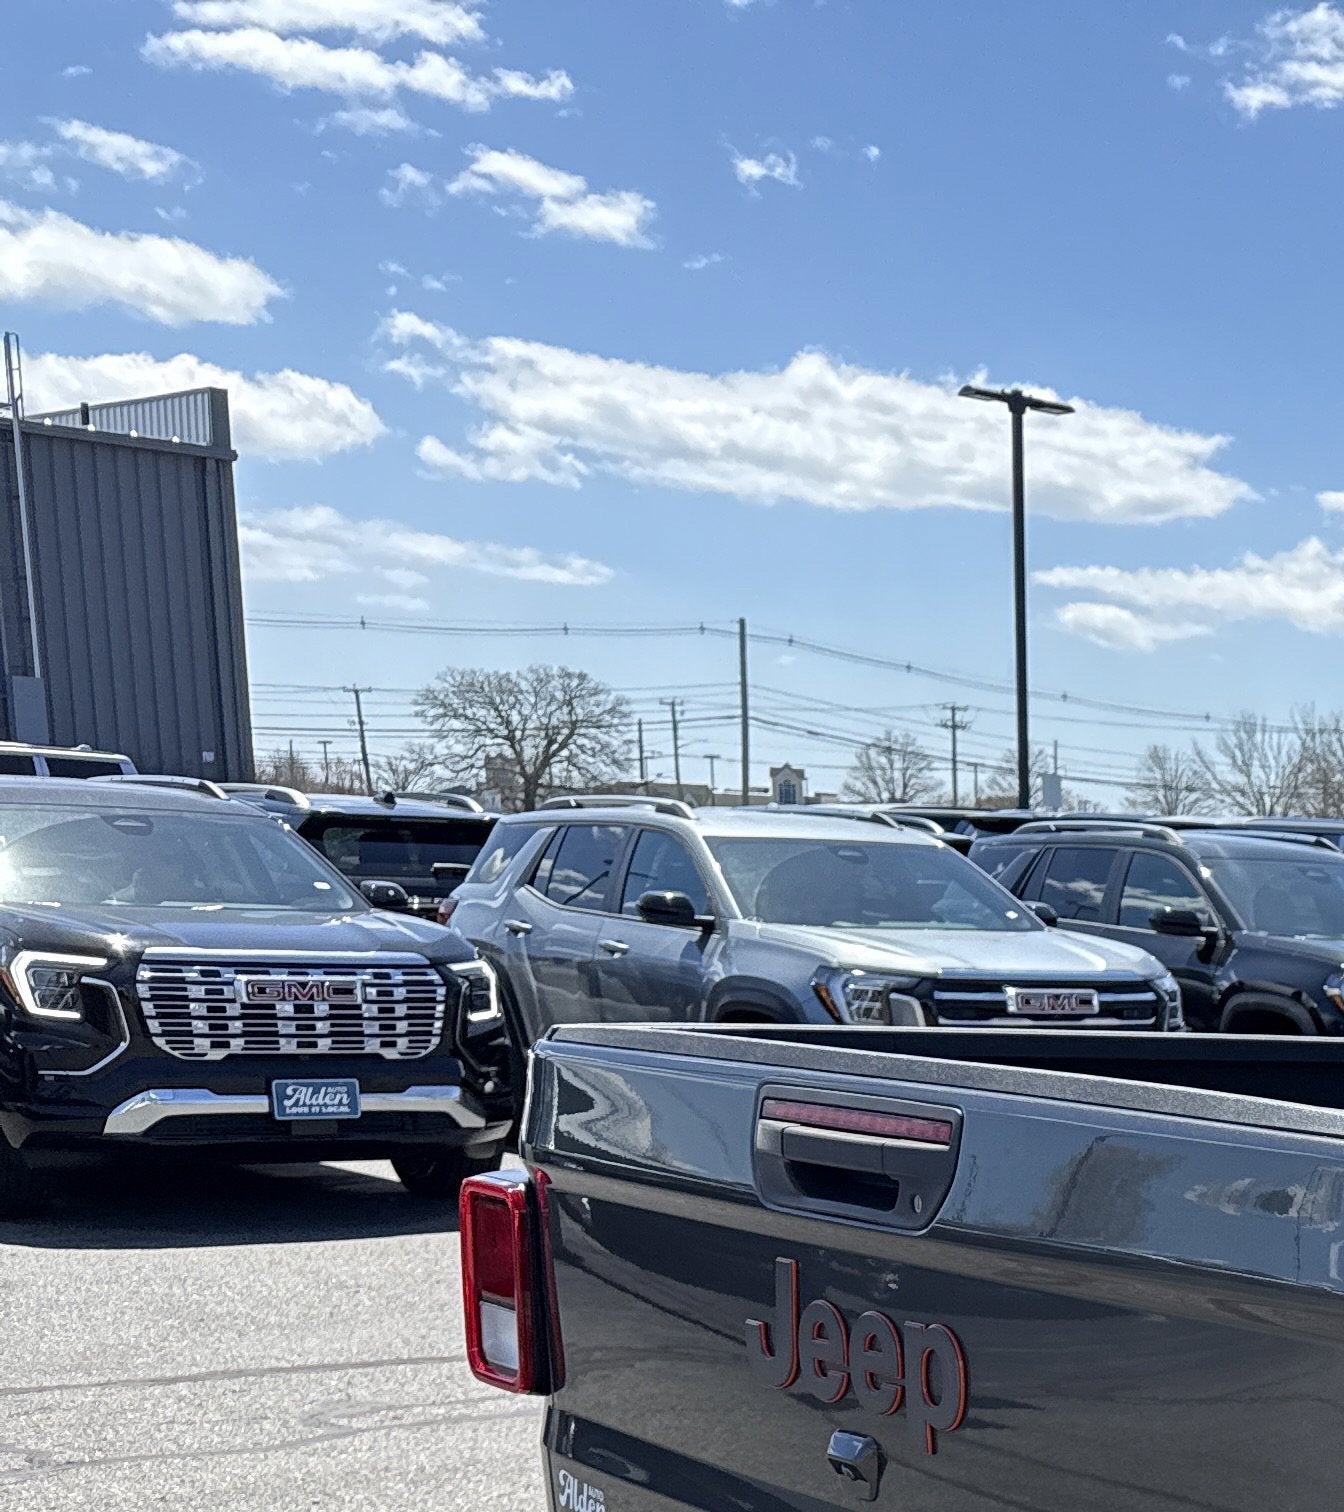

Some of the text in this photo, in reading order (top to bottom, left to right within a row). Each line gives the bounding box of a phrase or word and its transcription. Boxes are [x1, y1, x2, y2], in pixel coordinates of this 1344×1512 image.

[247, 981, 358, 1001] GMC
[1018, 993, 1094, 1012] GMC
[283, 1085, 351, 1106] Alden
[745, 1257, 968, 1455] Jeep
